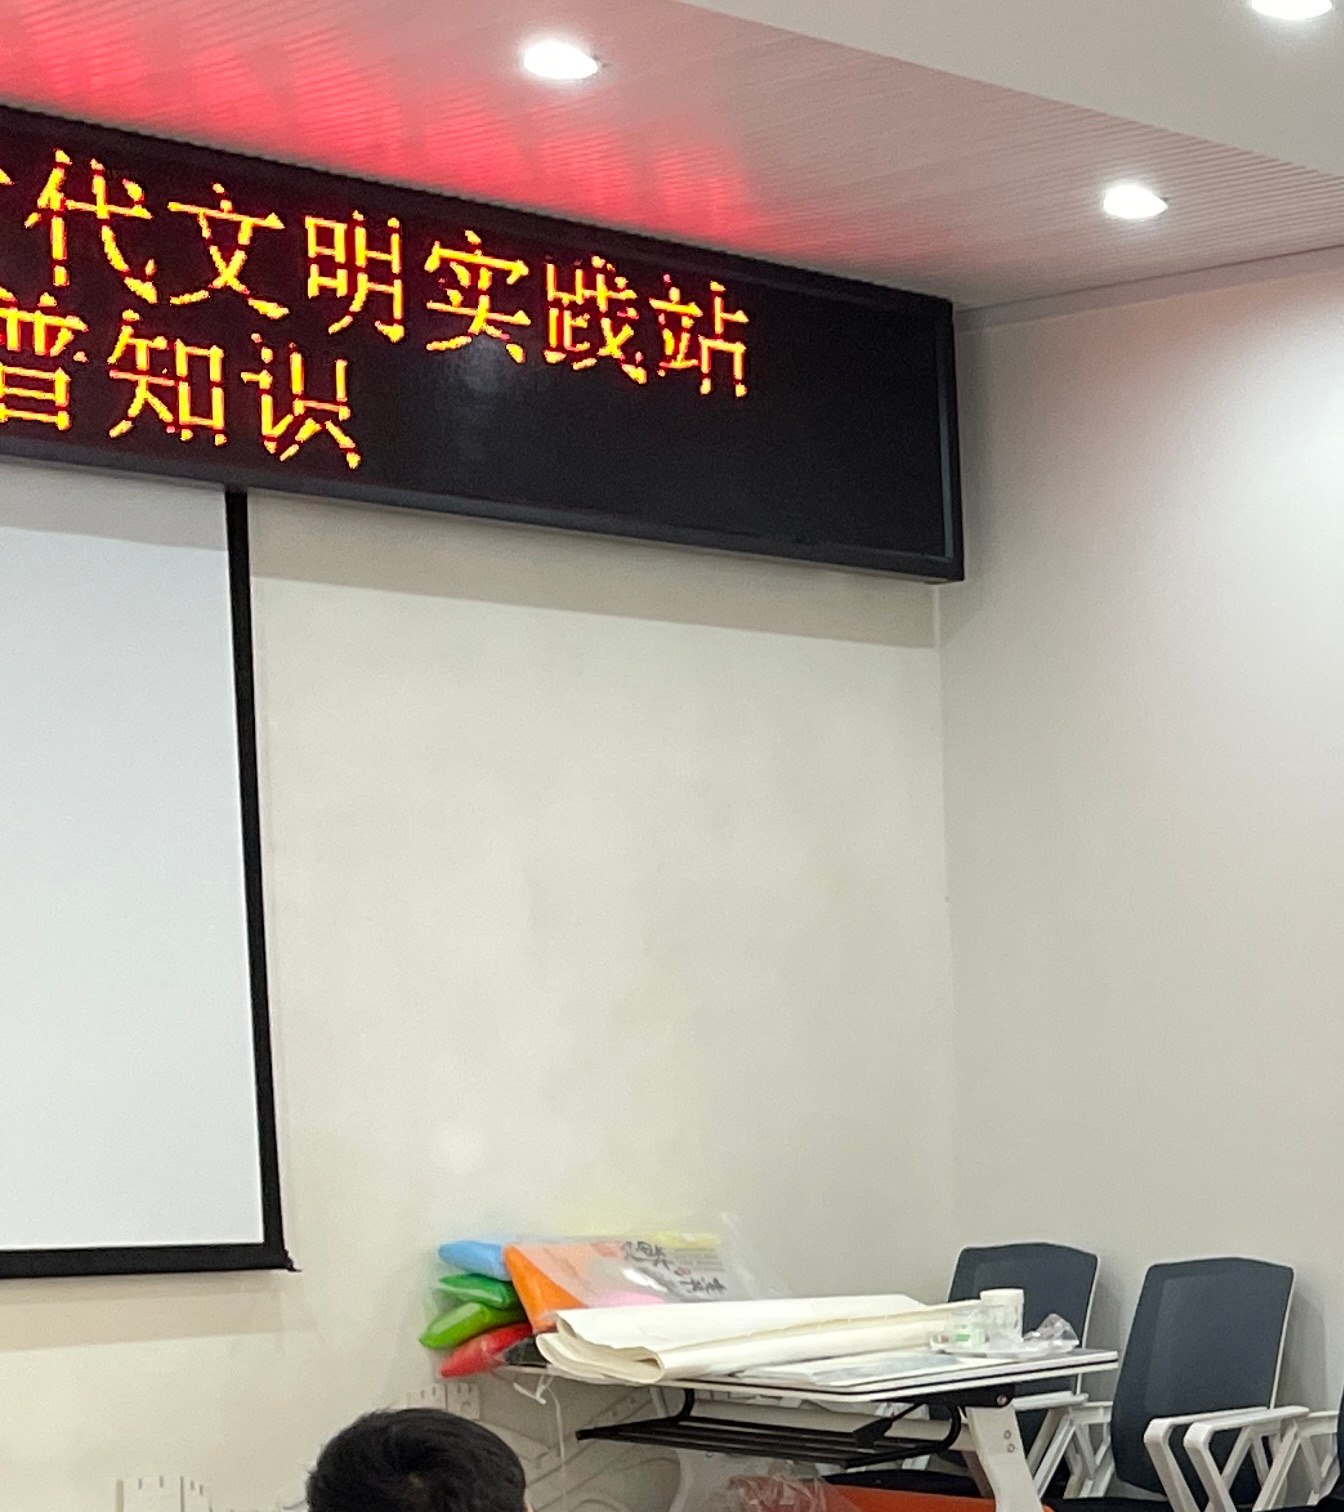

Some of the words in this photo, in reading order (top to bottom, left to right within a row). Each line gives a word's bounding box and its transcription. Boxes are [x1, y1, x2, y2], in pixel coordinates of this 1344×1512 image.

[0, 148, 750, 398] 代文明实践站
[0, 285, 361, 468] 普知识
